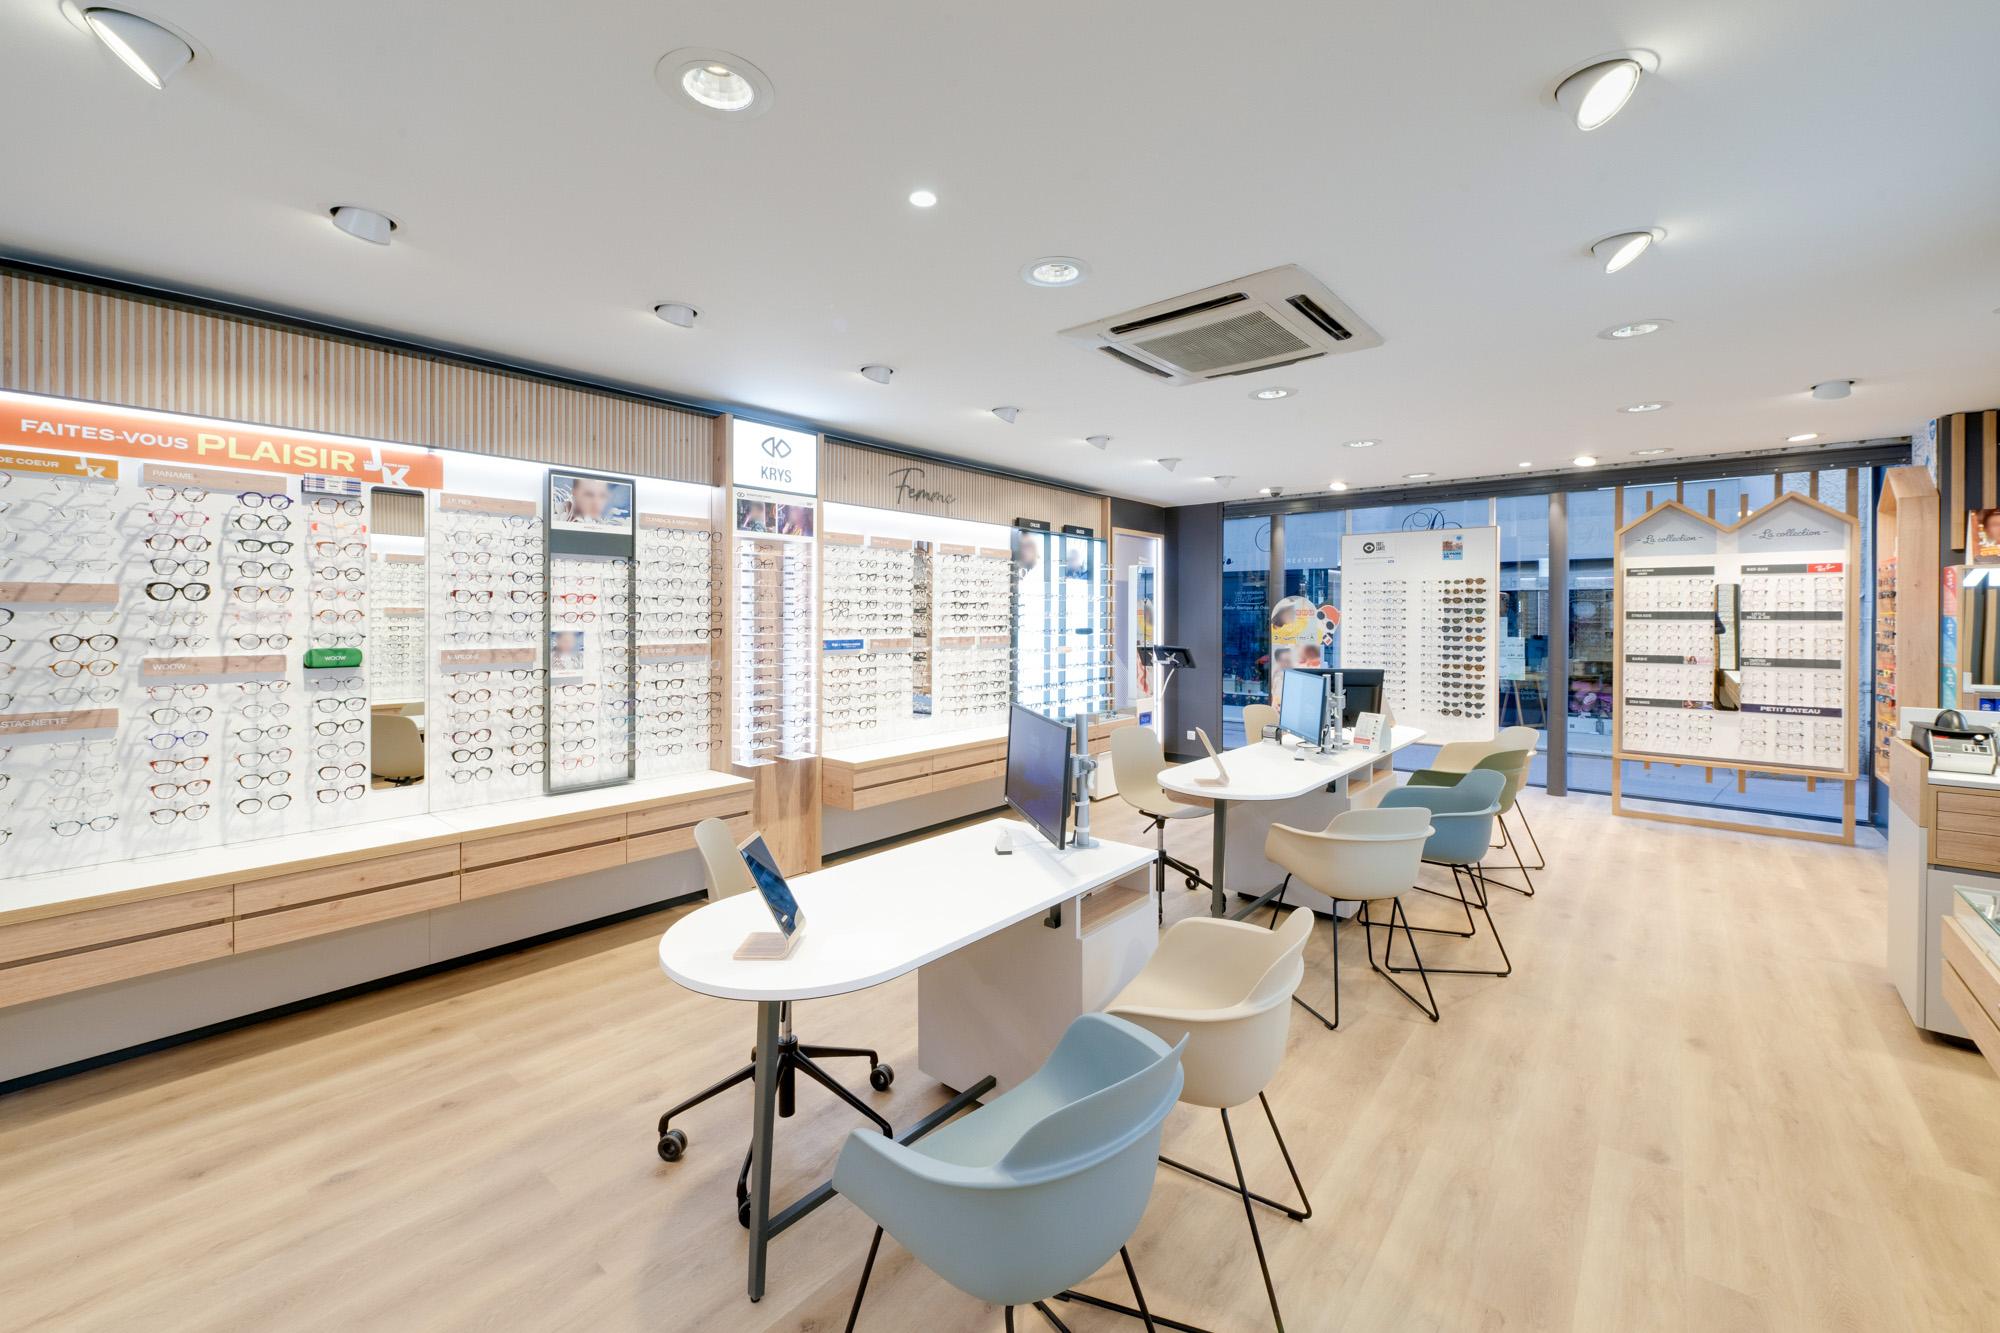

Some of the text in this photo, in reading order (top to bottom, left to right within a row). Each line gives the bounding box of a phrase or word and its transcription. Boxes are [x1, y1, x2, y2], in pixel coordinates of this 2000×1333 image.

[20, 418, 356, 473] FAITES-VOUS PLAISIR
[15, 457, 60, 468] COEUR
[760, 465, 793, 484] KRYS
[1643, 532, 1697, 545] La collection
[1758, 527, 1821, 540] La collection
[323, 654, 348, 662] WOOW
[152, 663, 186, 672] WOOW
[1760, 705, 1821, 715] PETIT BATEAU
